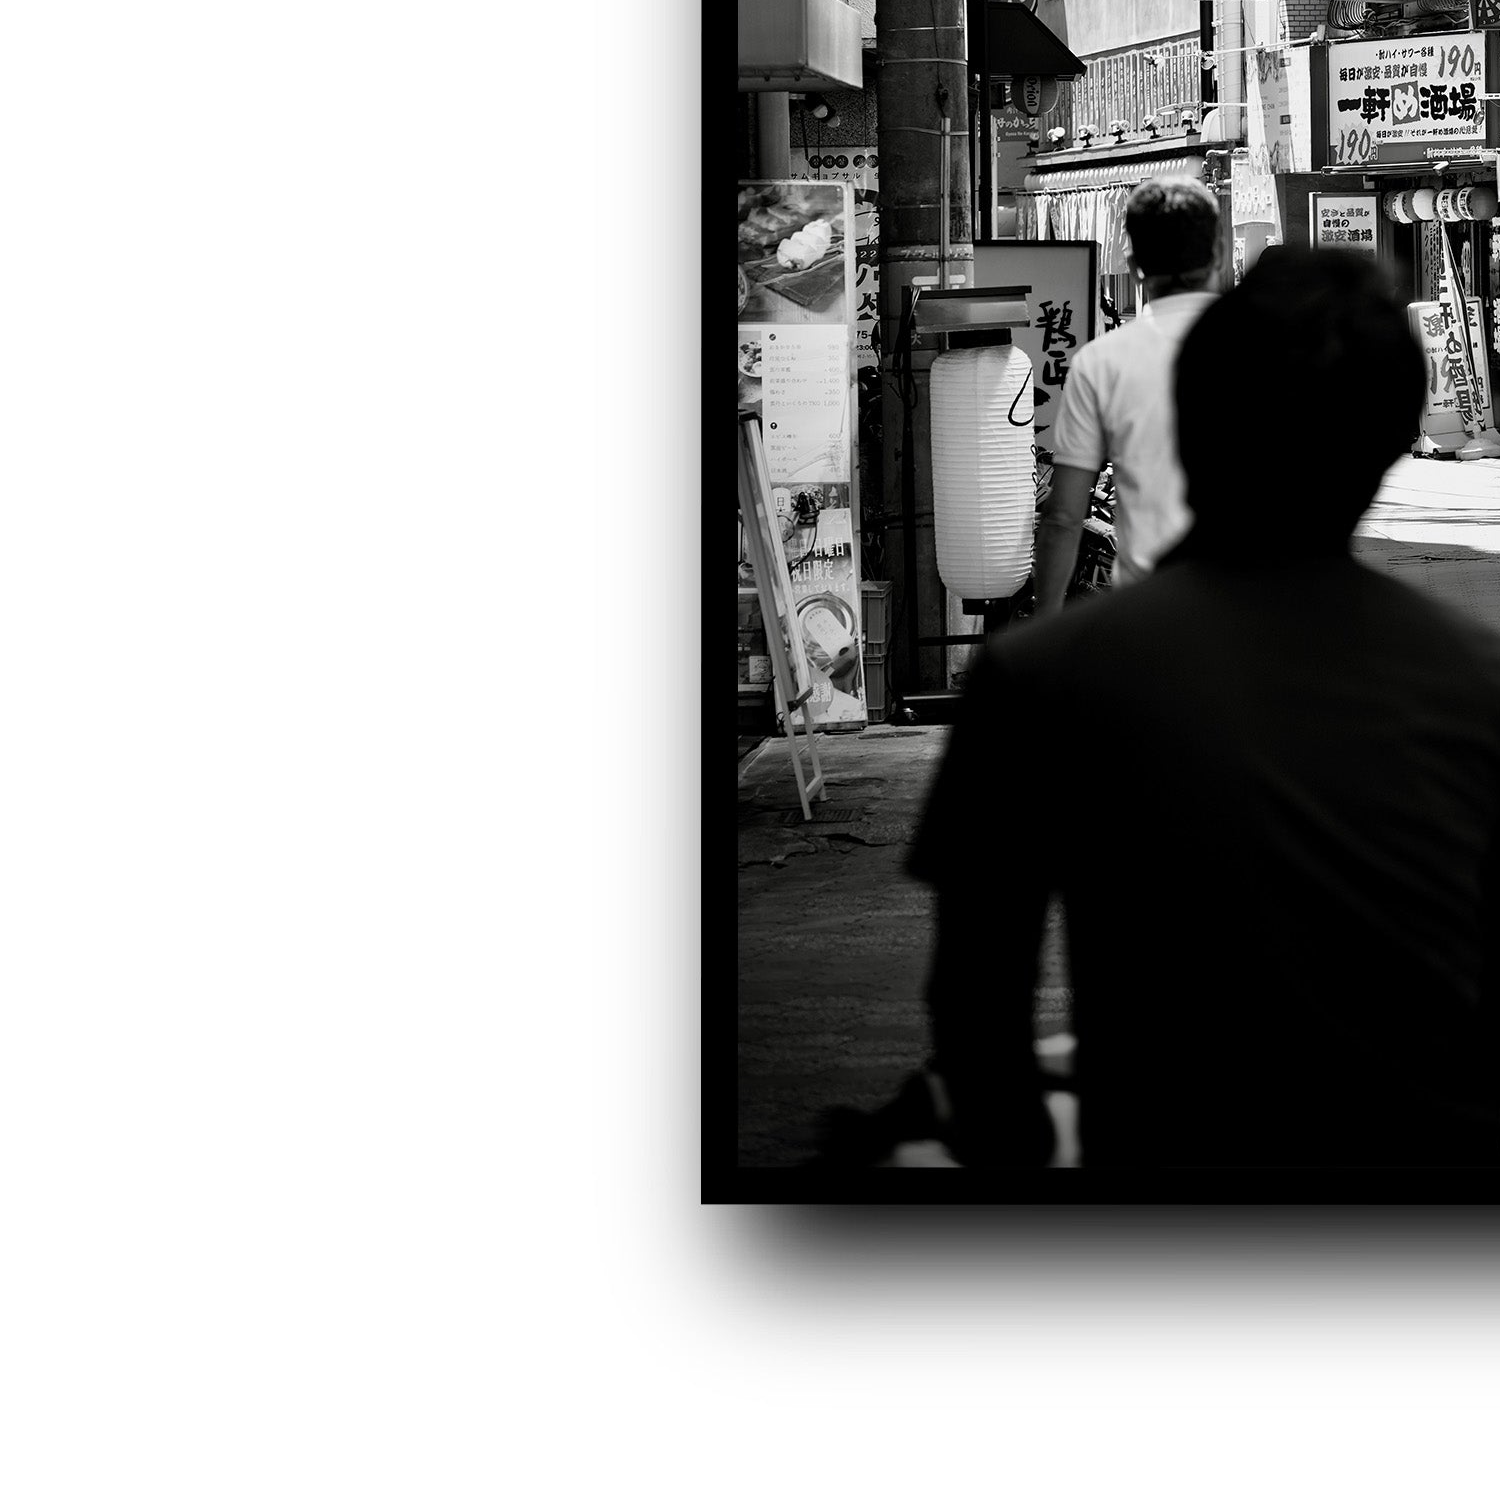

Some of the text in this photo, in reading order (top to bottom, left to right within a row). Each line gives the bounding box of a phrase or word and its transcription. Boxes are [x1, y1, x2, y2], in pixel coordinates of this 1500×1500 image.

[1337, 83, 1478, 125] 一軒め酒場
[1321, 229, 1374, 242] 激安酒場
